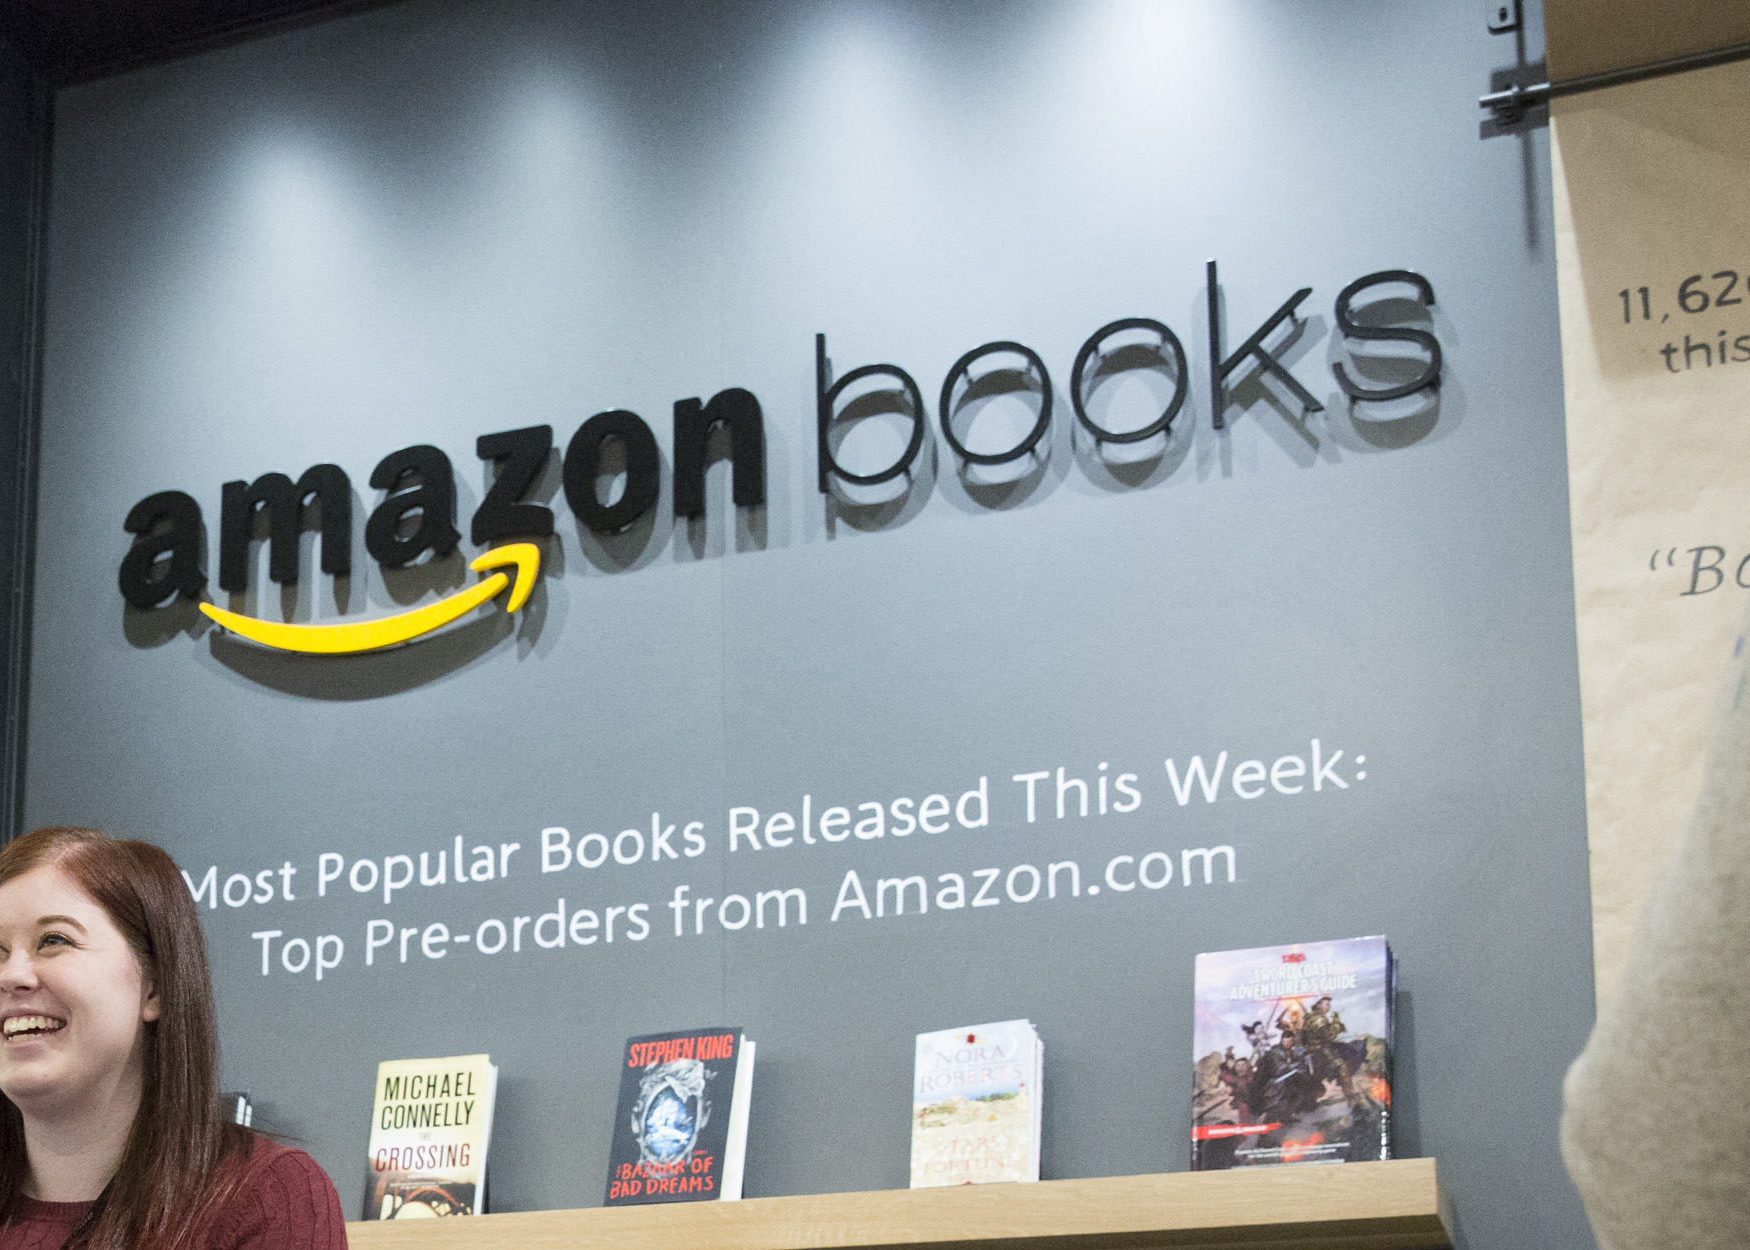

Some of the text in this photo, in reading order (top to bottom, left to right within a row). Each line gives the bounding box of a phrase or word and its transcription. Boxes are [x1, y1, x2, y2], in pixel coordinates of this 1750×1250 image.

[1619, 270, 1750, 325] 11,62
[1659, 329, 1750, 373] this
[119, 259, 1446, 611] amazon books
[317, 835, 521, 905] Popular
[540, 811, 706, 875] Books
[728, 775, 989, 853] Released
[1012, 762, 1141, 824] This
[1164, 738, 1367, 807] Week:
[251, 843, 1237, 982] Top Pre-orders from Amazon.com
[627, 1034, 735, 1068] STEPHEN KING
[935, 1046, 1005, 1068] NORA
[384, 1071, 476, 1102] MICHAEL
[919, 1065, 1023, 1093] ROBERTS
[380, 1100, 475, 1131] CONNELLY
[374, 1143, 471, 1173] CROSSING
[621, 1156, 714, 1181] BAZAAR OF
[609, 1175, 715, 1200] BAD DREAMS
